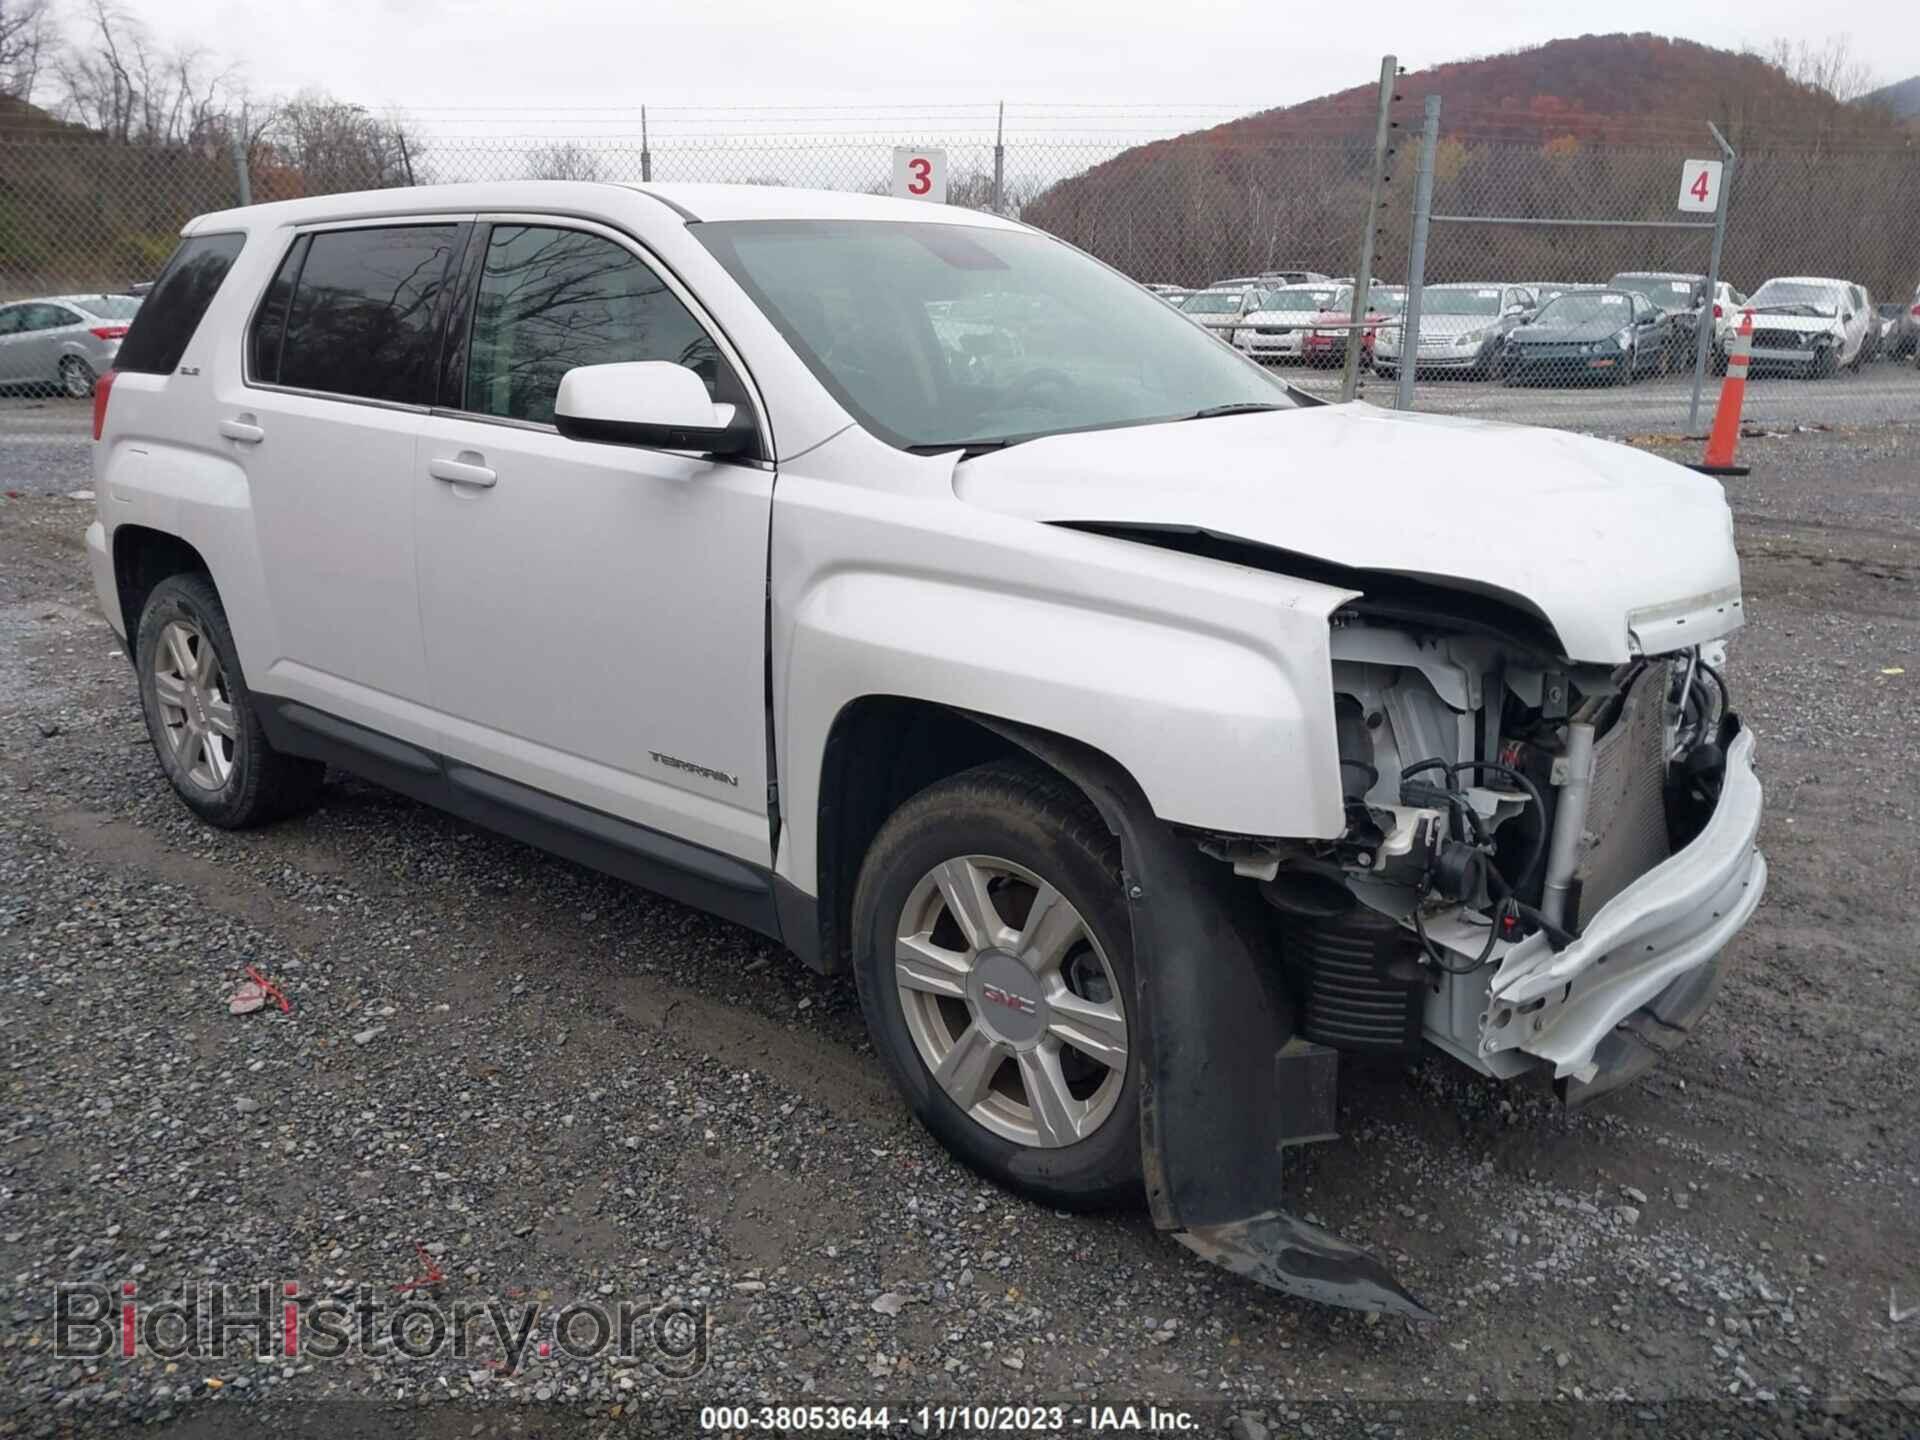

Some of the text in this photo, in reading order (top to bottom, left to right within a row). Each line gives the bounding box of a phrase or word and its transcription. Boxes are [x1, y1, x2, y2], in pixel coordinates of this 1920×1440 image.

[908, 158, 932, 195] 3
[1690, 171, 1709, 202] 4
[983, 982, 1036, 1015] GMC
